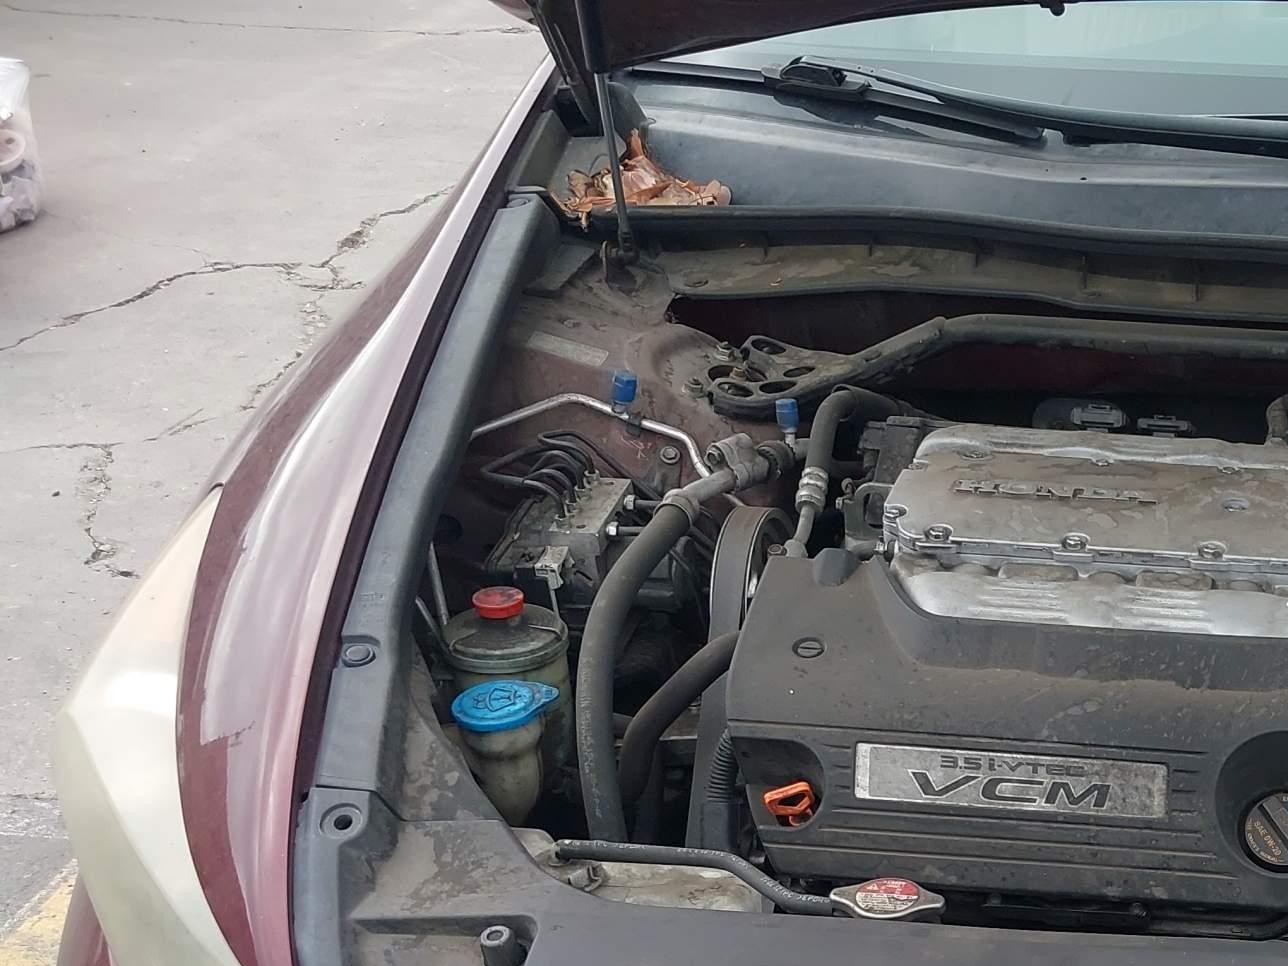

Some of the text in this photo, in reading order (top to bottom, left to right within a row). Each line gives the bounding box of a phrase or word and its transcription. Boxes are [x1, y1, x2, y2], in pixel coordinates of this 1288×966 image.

[953, 479, 1158, 505] HONDA
[940, 755, 982, 771] 3.5
[907, 768, 1112, 810] VCM
[1254, 821, 1268, 837] SAE
